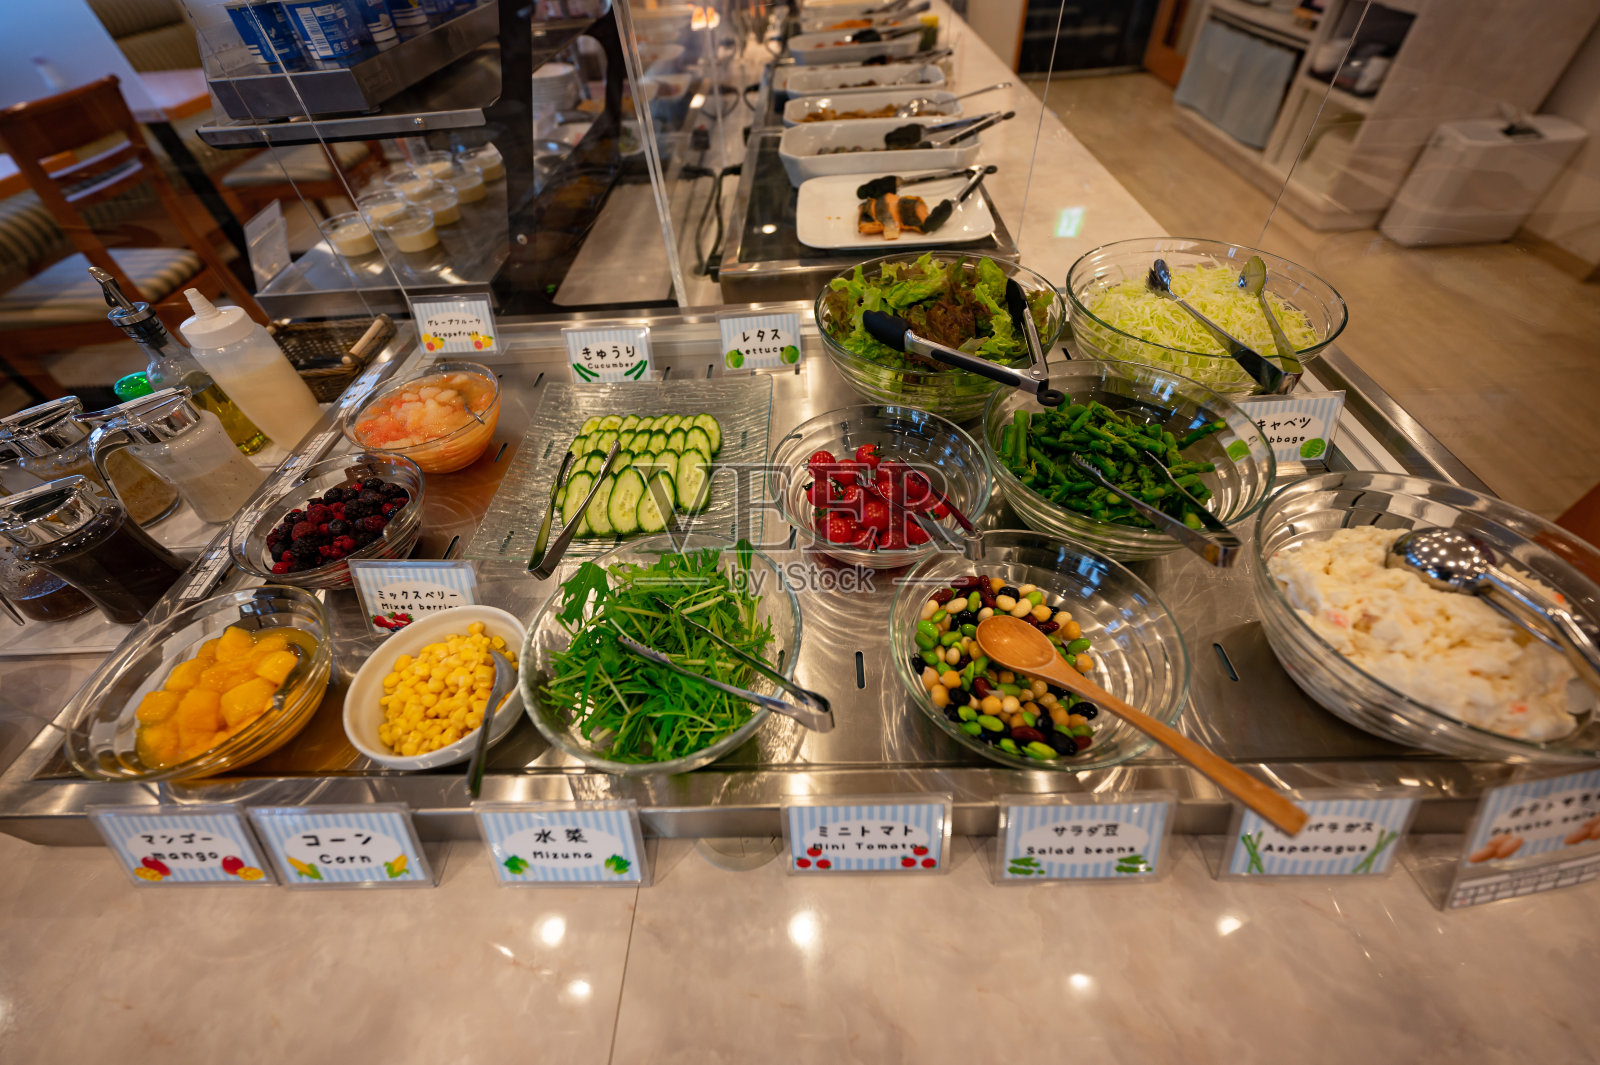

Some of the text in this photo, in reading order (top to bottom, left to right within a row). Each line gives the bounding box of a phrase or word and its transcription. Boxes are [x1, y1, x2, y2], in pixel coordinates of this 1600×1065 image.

[742, 329, 780, 342] レタス
[582, 345, 635, 360] きゅうり
[736, 346, 785, 356] Lettuce
[1257, 416, 1311, 430] キャベツ
[378, 590, 458, 600] ミックスベリー
[534, 828, 588, 843] 水菜
[818, 825, 914, 838] ミニトマト
[1052, 823, 1120, 837] サラダ豆
[141, 833, 213, 844] マンゴー
[302, 833, 372, 846] コーン
[855, 842, 919, 850] Tomato
[1027, 846, 1136, 855] Salad beans
[1263, 844, 1368, 855] Asparagus
[151, 851, 219, 861] mango
[319, 854, 371, 864] Corn
[532, 851, 593, 860] Mizuna
